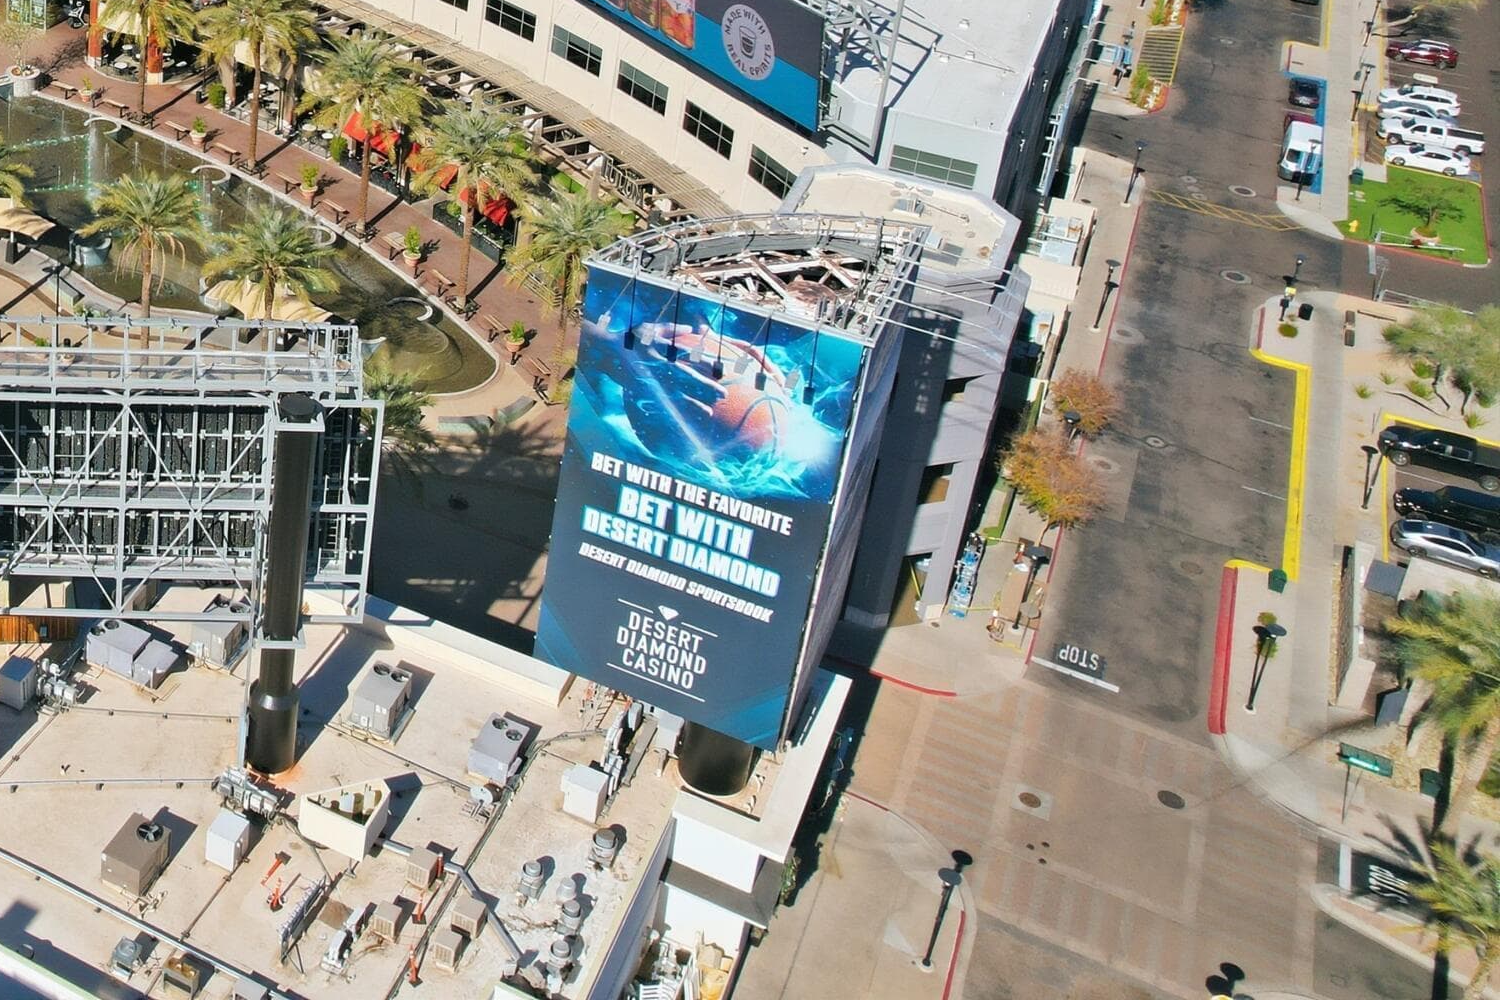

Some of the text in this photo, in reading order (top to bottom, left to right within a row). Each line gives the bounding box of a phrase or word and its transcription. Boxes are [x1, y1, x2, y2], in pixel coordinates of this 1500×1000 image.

[724, 8, 766, 35] MADE WITH
[727, 44, 771, 76] REAL SPIRITS
[591, 451, 793, 536] BET WITH THE FAVORITE
[617, 483, 754, 559] BET WITH
[583, 506, 780, 598] DESERT DIAMOND
[578, 542, 774, 623] DESERT DIAMOND SPORTSBOOK
[616, 626, 707, 676] DIAMOND
[628, 611, 703, 653] DESERT
[621, 648, 695, 690] CASINO
[1059, 644, 1100, 671] STOP
